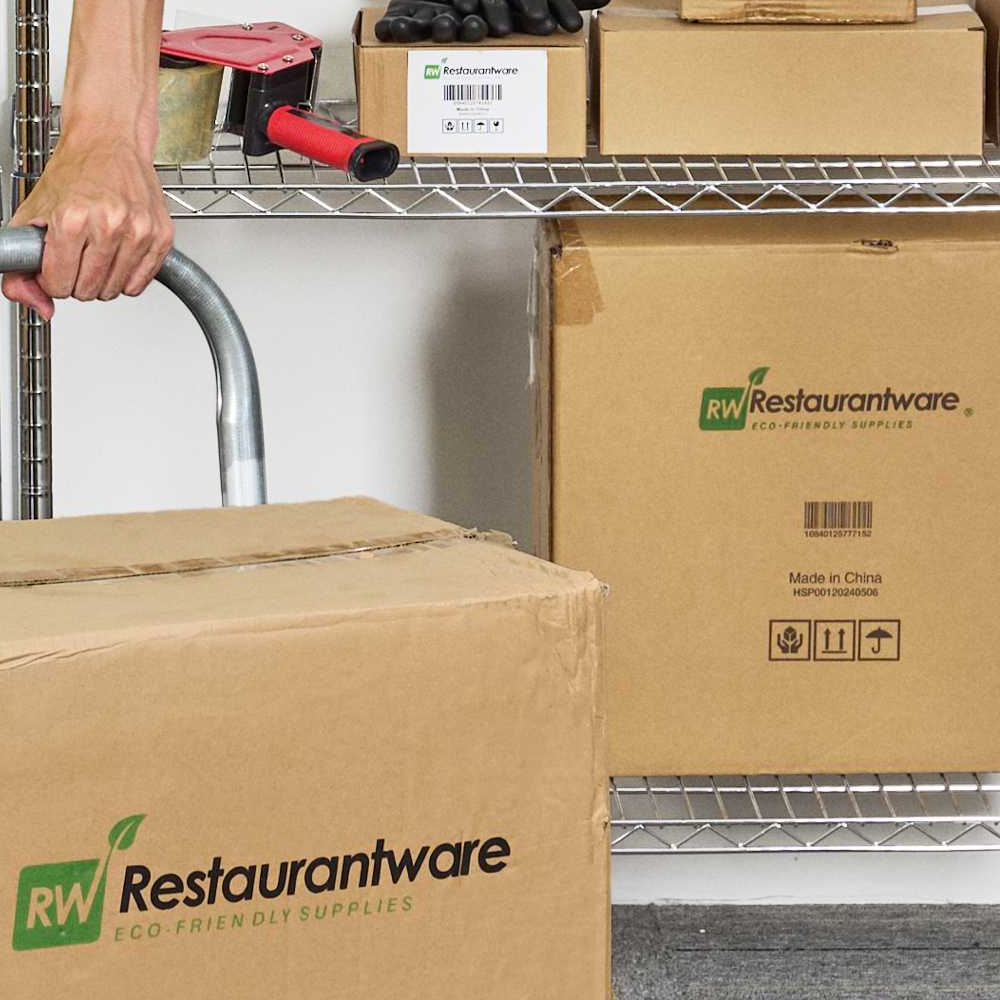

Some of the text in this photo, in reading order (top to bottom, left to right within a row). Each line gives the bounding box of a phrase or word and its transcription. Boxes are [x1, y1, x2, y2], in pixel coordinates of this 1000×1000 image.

[443, 66, 519, 76] Restaurantware
[707, 387, 960, 419] RW Restaurantware
[752, 420, 914, 431] ECO-FRIENDLY SUPPLIES
[788, 571, 883, 585] Made in China
[793, 587, 879, 597] HSP00120240506
[26, 836, 511, 929] RW Restaurantware
[114, 895, 414, 942] ECO-FRIENDLY SUPPLIES
